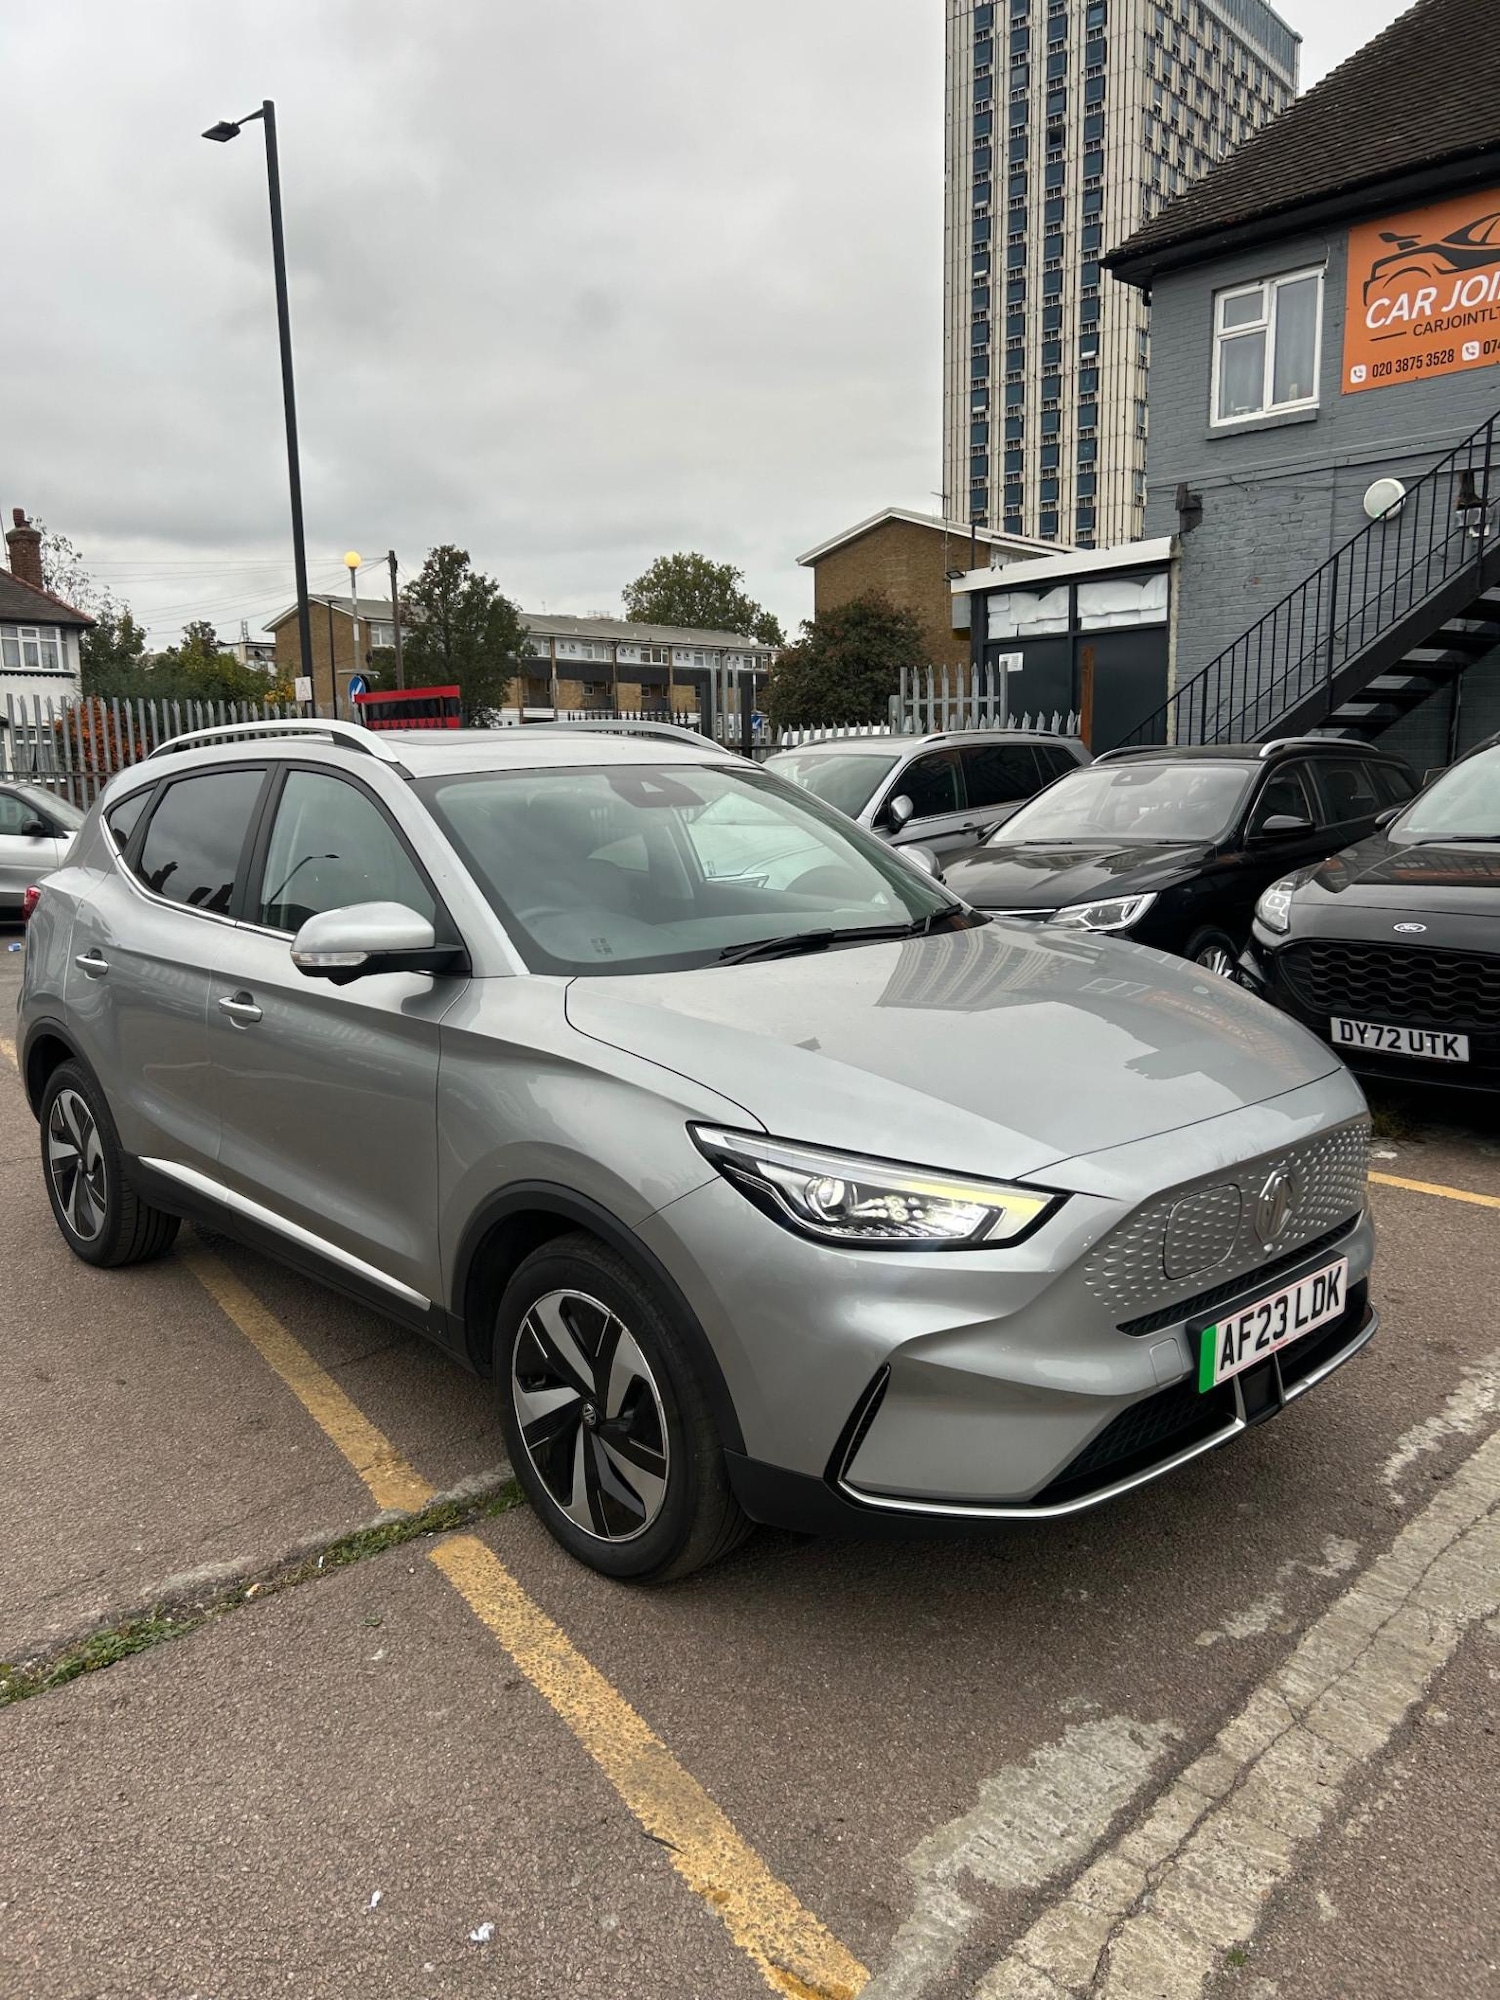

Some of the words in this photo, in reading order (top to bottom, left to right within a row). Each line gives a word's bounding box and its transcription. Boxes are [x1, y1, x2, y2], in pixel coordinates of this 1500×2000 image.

[1366, 287, 1437, 329] CAR
[1441, 270, 1500, 313] JOI
[1372, 361, 1392, 378] 020
[1395, 355, 1423, 374] 3875
[1426, 348, 1455, 367] 3528
[1340, 1020, 1402, 1050] DY72
[1408, 1030, 1459, 1058] UTK
[1219, 1294, 1289, 1371] AF23
[1295, 1266, 1342, 1330] LDK
